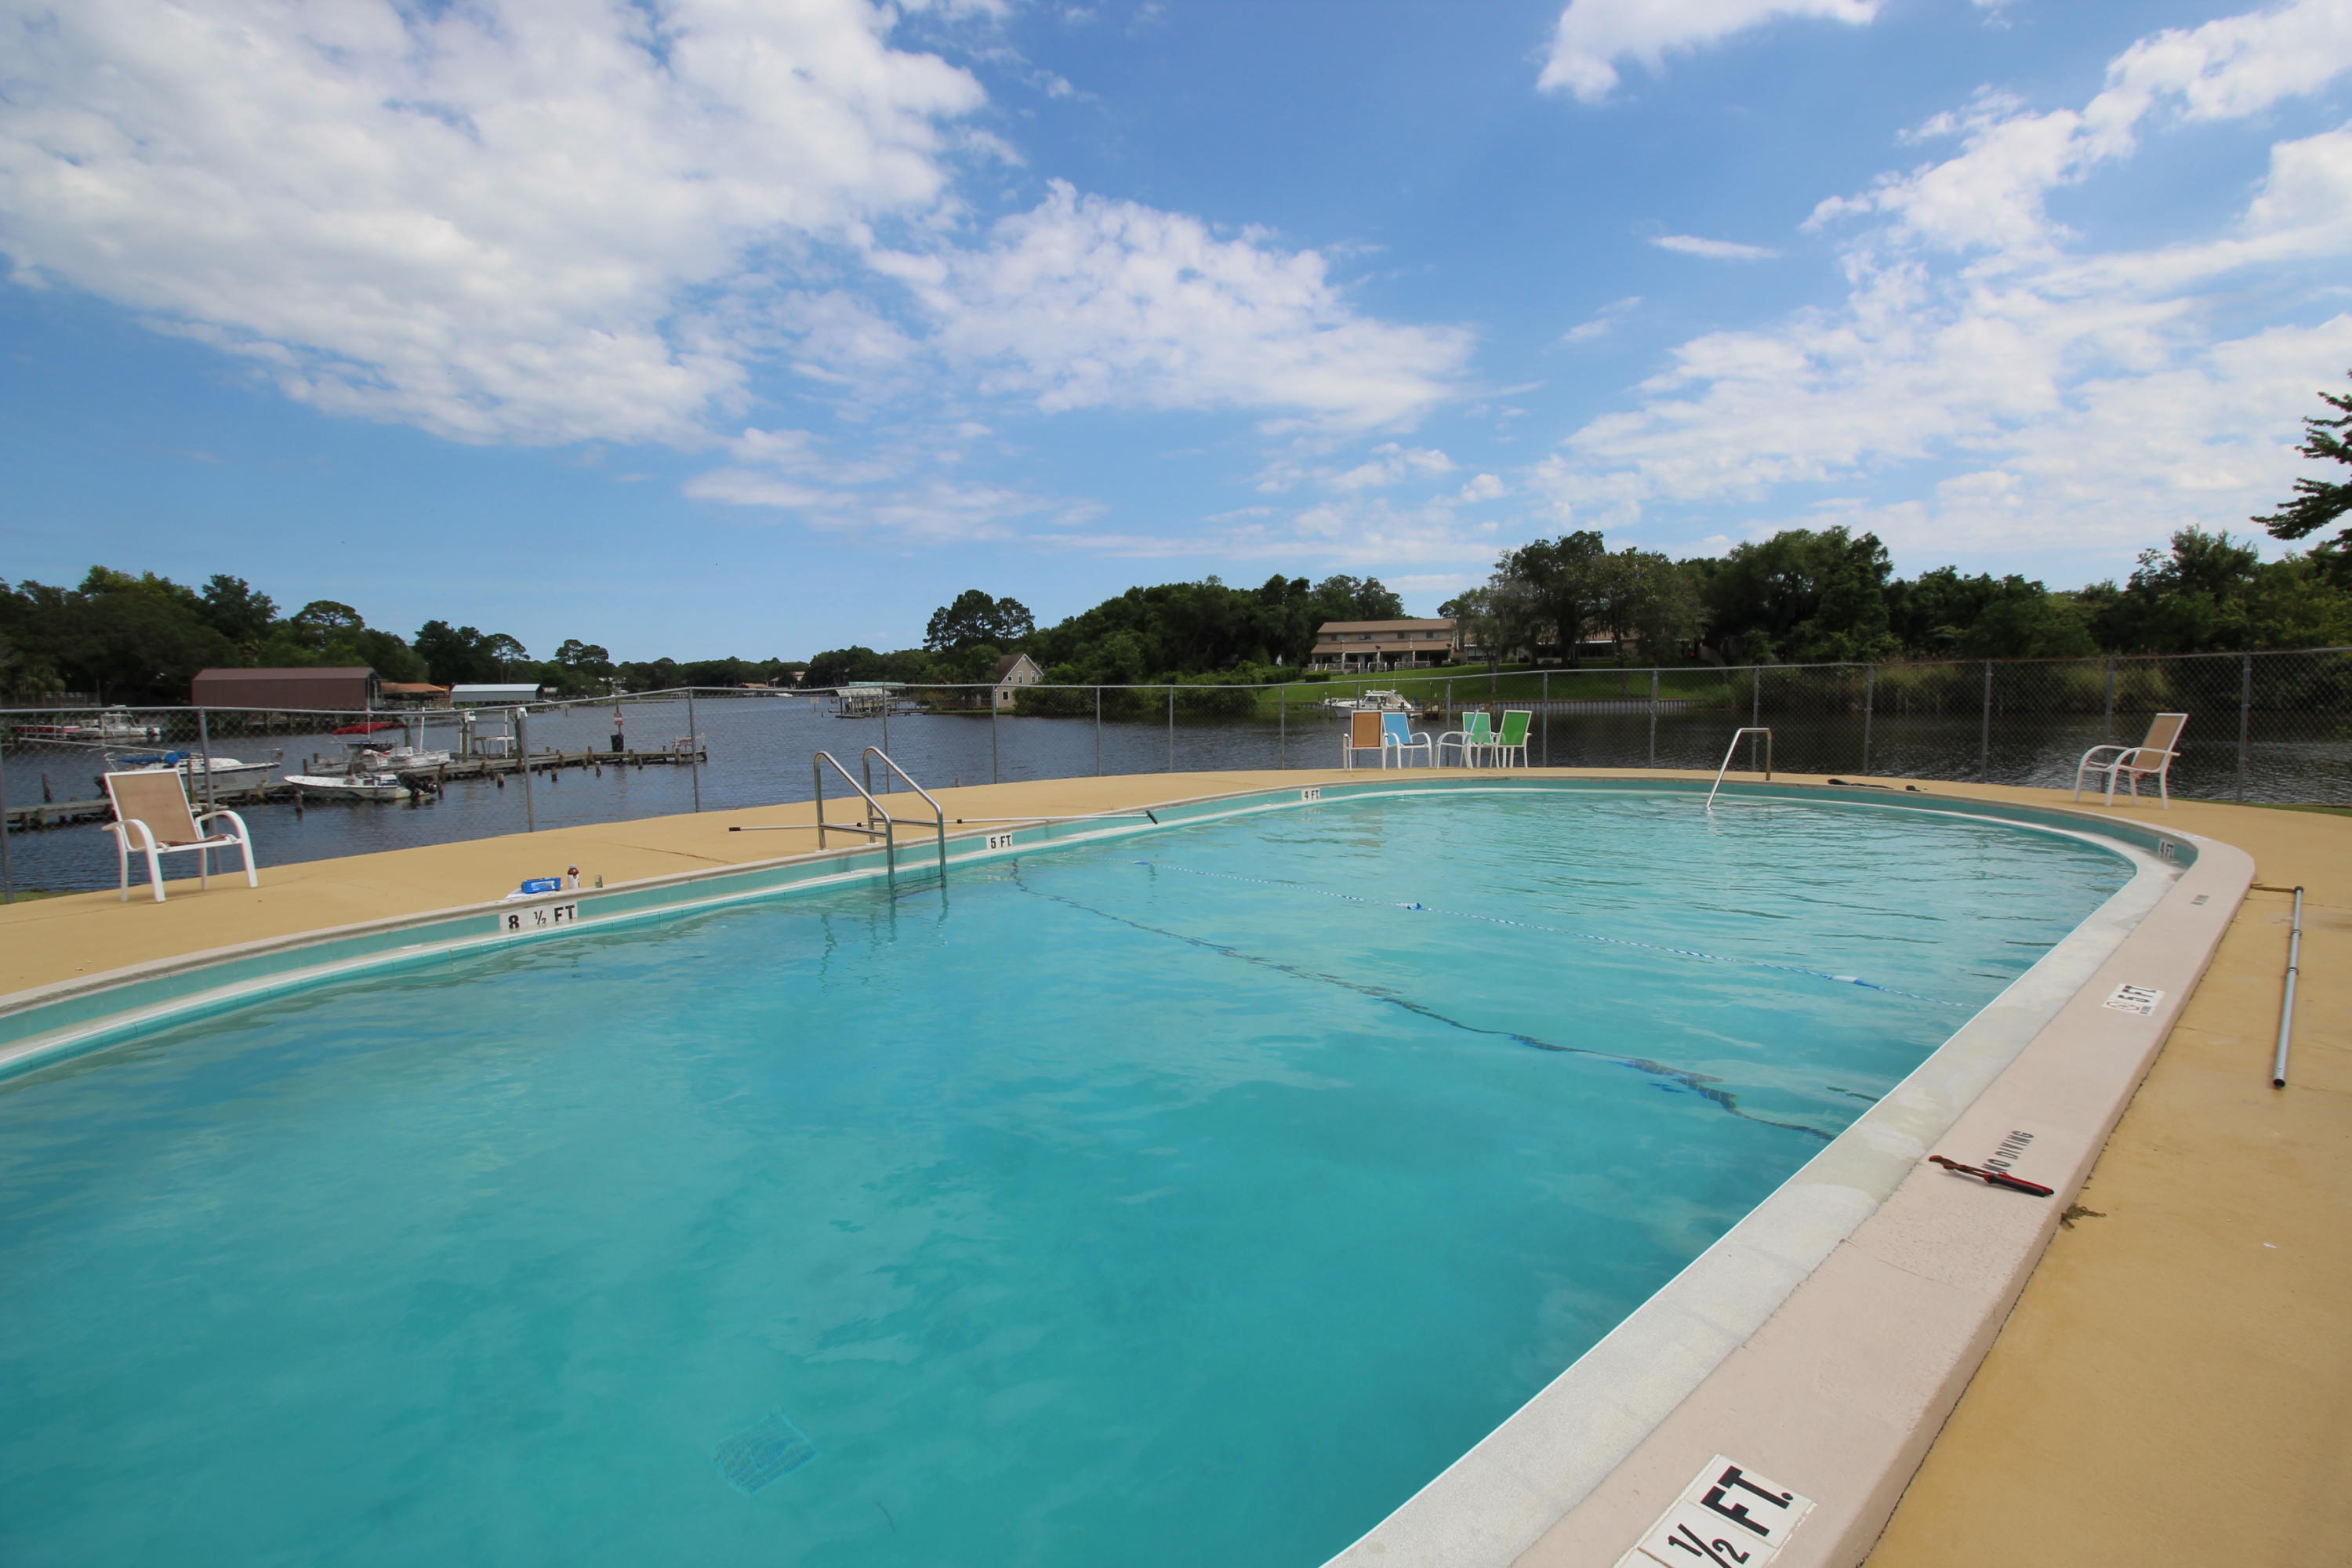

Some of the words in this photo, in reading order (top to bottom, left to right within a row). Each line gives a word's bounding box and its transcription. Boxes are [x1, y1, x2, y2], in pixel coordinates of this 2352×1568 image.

[1304, 790, 1308, 800] 4
[990, 837, 996, 849] 5
[508, 914, 520, 929] 8
[2118, 994, 2150, 1003] 5
[1994, 1131, 2034, 1160] DIVING
[1700, 1465, 1794, 1537] FT.
